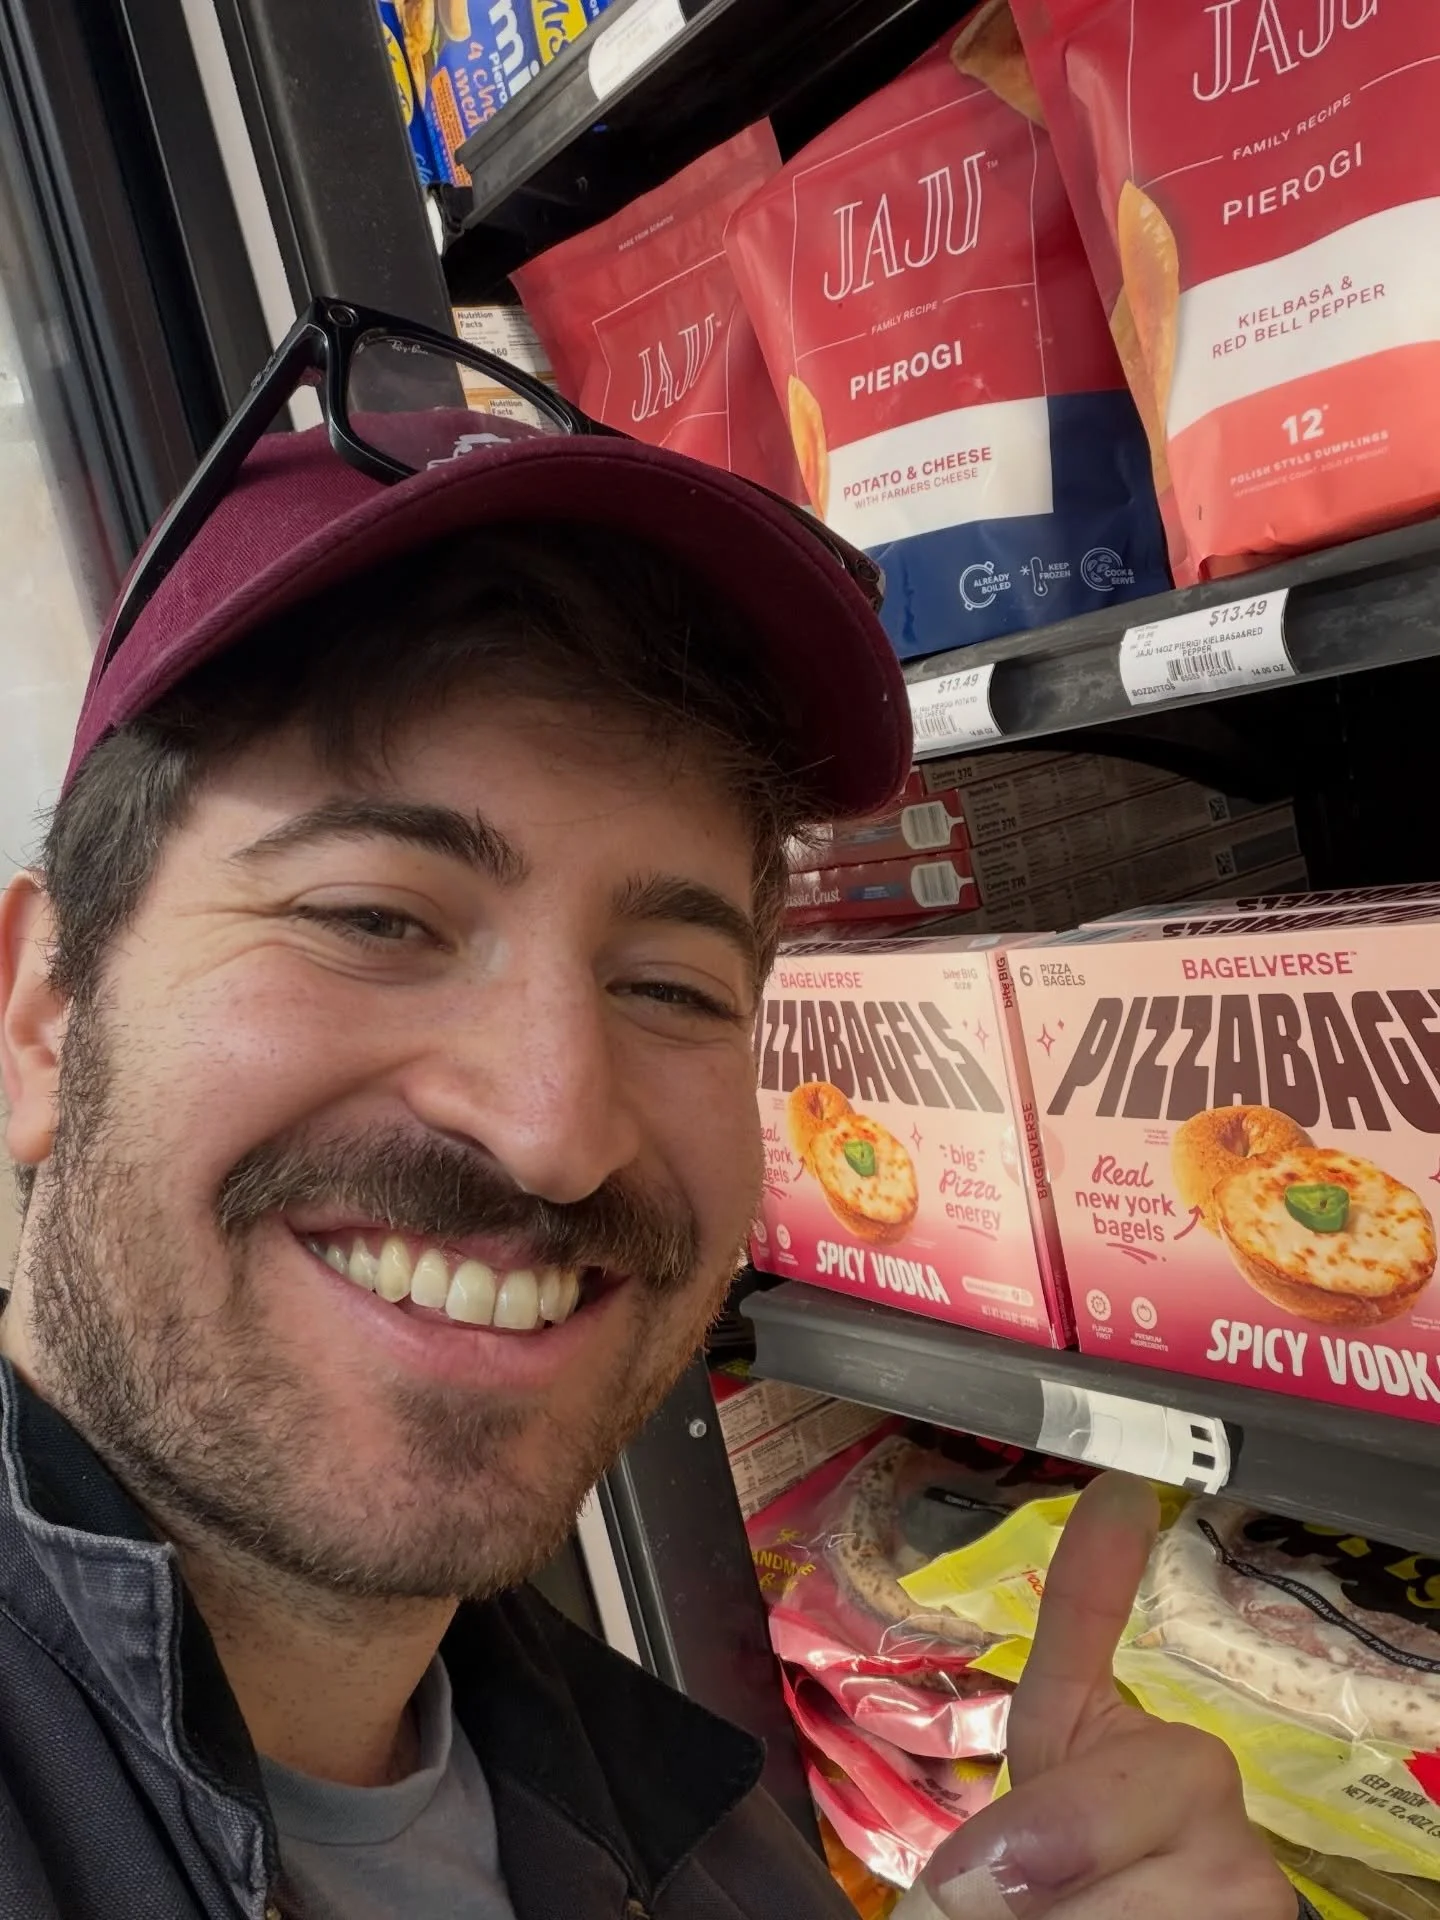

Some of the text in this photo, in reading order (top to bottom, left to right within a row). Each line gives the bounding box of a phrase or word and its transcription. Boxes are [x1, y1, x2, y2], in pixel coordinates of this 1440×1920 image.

[468, 41, 485, 61] 4
[1232, 93, 1352, 160] FAMILY RECIPE
[1222, 141, 1364, 225] PIEROGI
[823, 151, 986, 302] JAJU
[1237, 275, 1353, 328] KIELBASA &
[870, 300, 938, 335] FAMILY RECIPE
[1211, 283, 1387, 359] RED BELL PEPPER
[849, 340, 963, 401] PIEROGI
[1229, 429, 1389, 486] POLISH STYLE DUMPLINGS
[843, 446, 993, 501] POTATO & CHEESE
[854, 467, 979, 511] WITH FARMERS CHEESE
[973, 572, 1010, 588] ALREADY
[1039, 570, 1072, 580] FROZEN
[1048, 562, 1070, 571] KEEP
[1104, 569, 1128, 578] COOK
[981, 581, 1012, 595] BOILED
[1110, 577, 1136, 586] SERVE
[1208, 599, 1268, 627] $13.49
[1273, 663, 1287, 673] OZ
[937, 673, 979, 695] $13.49
[780, 971, 864, 989] BAGELVERSE
[1020, 965, 1034, 987] 6
[1040, 963, 1072, 975] PIZZA
[1043, 973, 1086, 987] BAGELS
[1182, 951, 1353, 981] BAGELVERSE
[1046, 989, 1440, 1134] PIZZABAGE
[761, 1127, 781, 1143] eal
[766, 1147, 793, 1165] york
[1021, 1102, 1049, 1201] BAGELVERSE
[1091, 1154, 1154, 1187] Real
[945, 1202, 1001, 1231] energy
[1075, 1190, 1176, 1218] new york
[1092, 1213, 1165, 1245] bagels
[815, 1240, 867, 1285] SPICY
[870, 1251, 952, 1305] VODKA
[1206, 1318, 1440, 1404] SPICY VODK
[1341, 1784, 1371, 1800] NET
[1359, 1774, 1430, 1808] KEEP FROZEN
